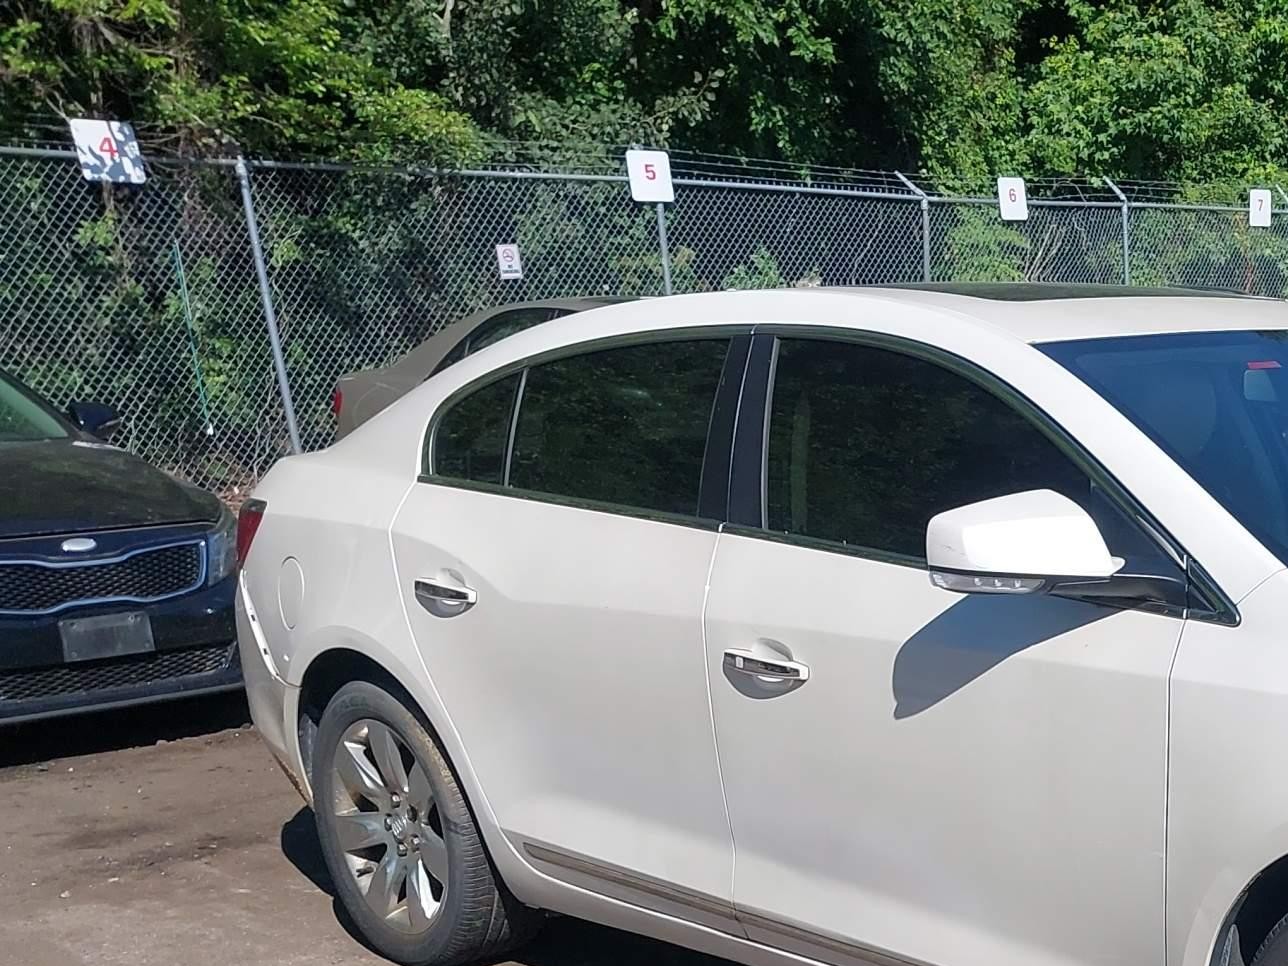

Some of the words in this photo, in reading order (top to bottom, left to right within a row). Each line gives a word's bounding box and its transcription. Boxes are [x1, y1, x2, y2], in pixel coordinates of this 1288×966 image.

[99, 137, 118, 160] 4
[644, 164, 657, 181] 5
[1008, 188, 1017, 203] 6
[1257, 198, 1264, 212] 7
